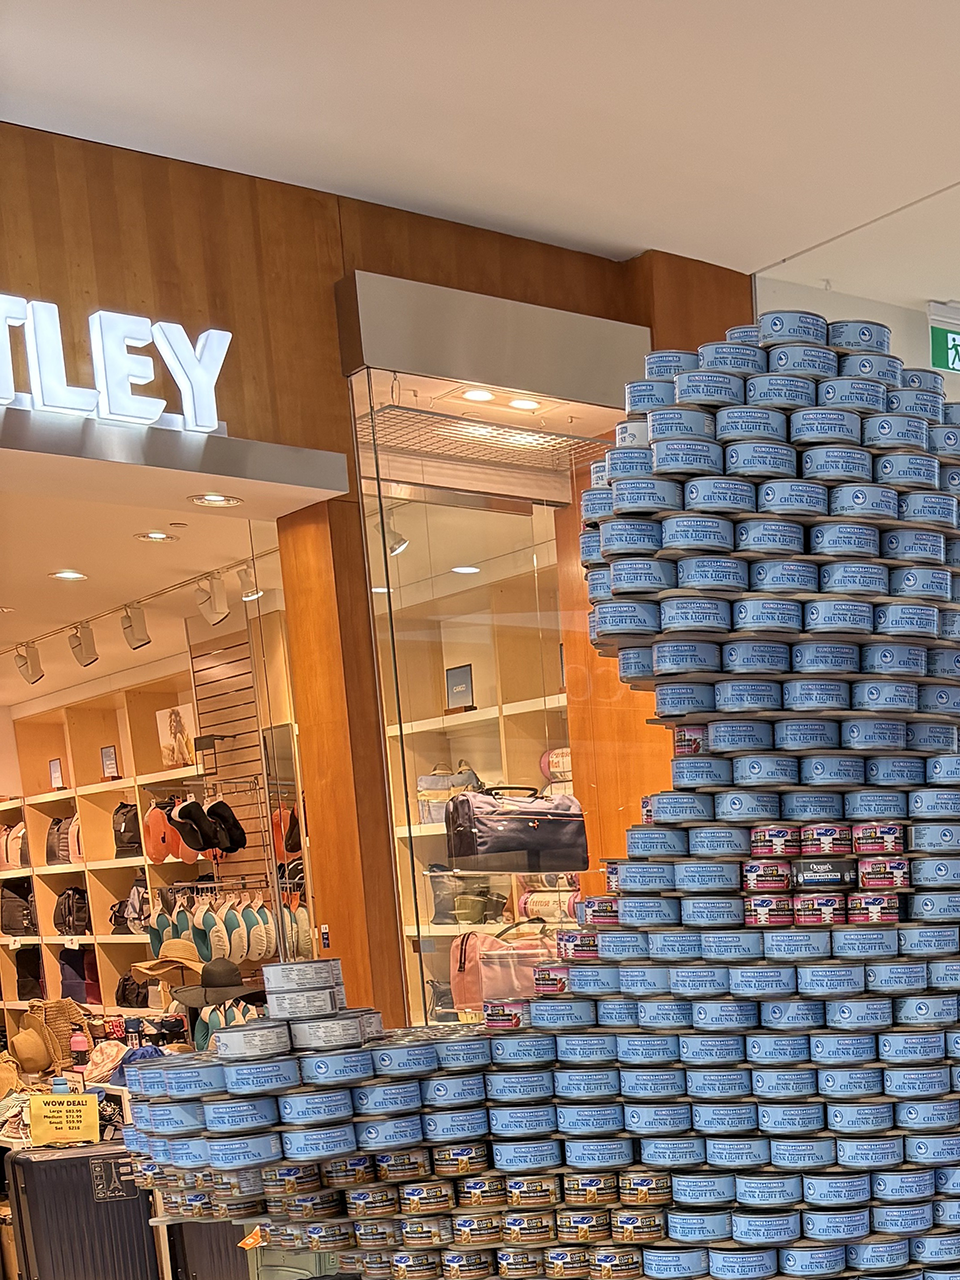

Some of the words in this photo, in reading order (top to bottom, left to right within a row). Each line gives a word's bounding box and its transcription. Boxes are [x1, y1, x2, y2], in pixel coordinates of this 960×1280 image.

[788, 328, 812, 336] CHUNK
[707, 359, 731, 367] CHUNK
[731, 359, 751, 368] LIGHT
[680, 387, 701, 395] CHUNK
[701, 387, 723, 395] LIGHT
[720, 424, 739, 433] CHUNK
[740, 424, 761, 432] LIGHT
[668, 532, 690, 541] CHUNK
[690, 532, 712, 540] LIGHT
[625, 574, 643, 583] LIGHT
[687, 571, 709, 580] CHUNK
[709, 572, 731, 580] LIGHT
[734, 981, 753, 989] CHUNK
[754, 981, 773, 989] LIGHT
[578, 1049, 596, 1057] LIGHT
[230, 1079, 250, 1087] CHUNK
[251, 1077, 274, 1087] LIGHT
[583, 1084, 601, 1092] LIGHT
[208, 1117, 226, 1126] CHUNK
[226, 1116, 249, 1125] LIGHT
[297, 1145, 320, 1153] CHUNK
[320, 1143, 340, 1152] LIGHT
[220, 1153, 240, 1162] LIGHT
[724, 1152, 743, 1160] LIGHT
[715, 1265, 736, 1273] CHUNK
[737, 1265, 755, 1273] LIGHT
